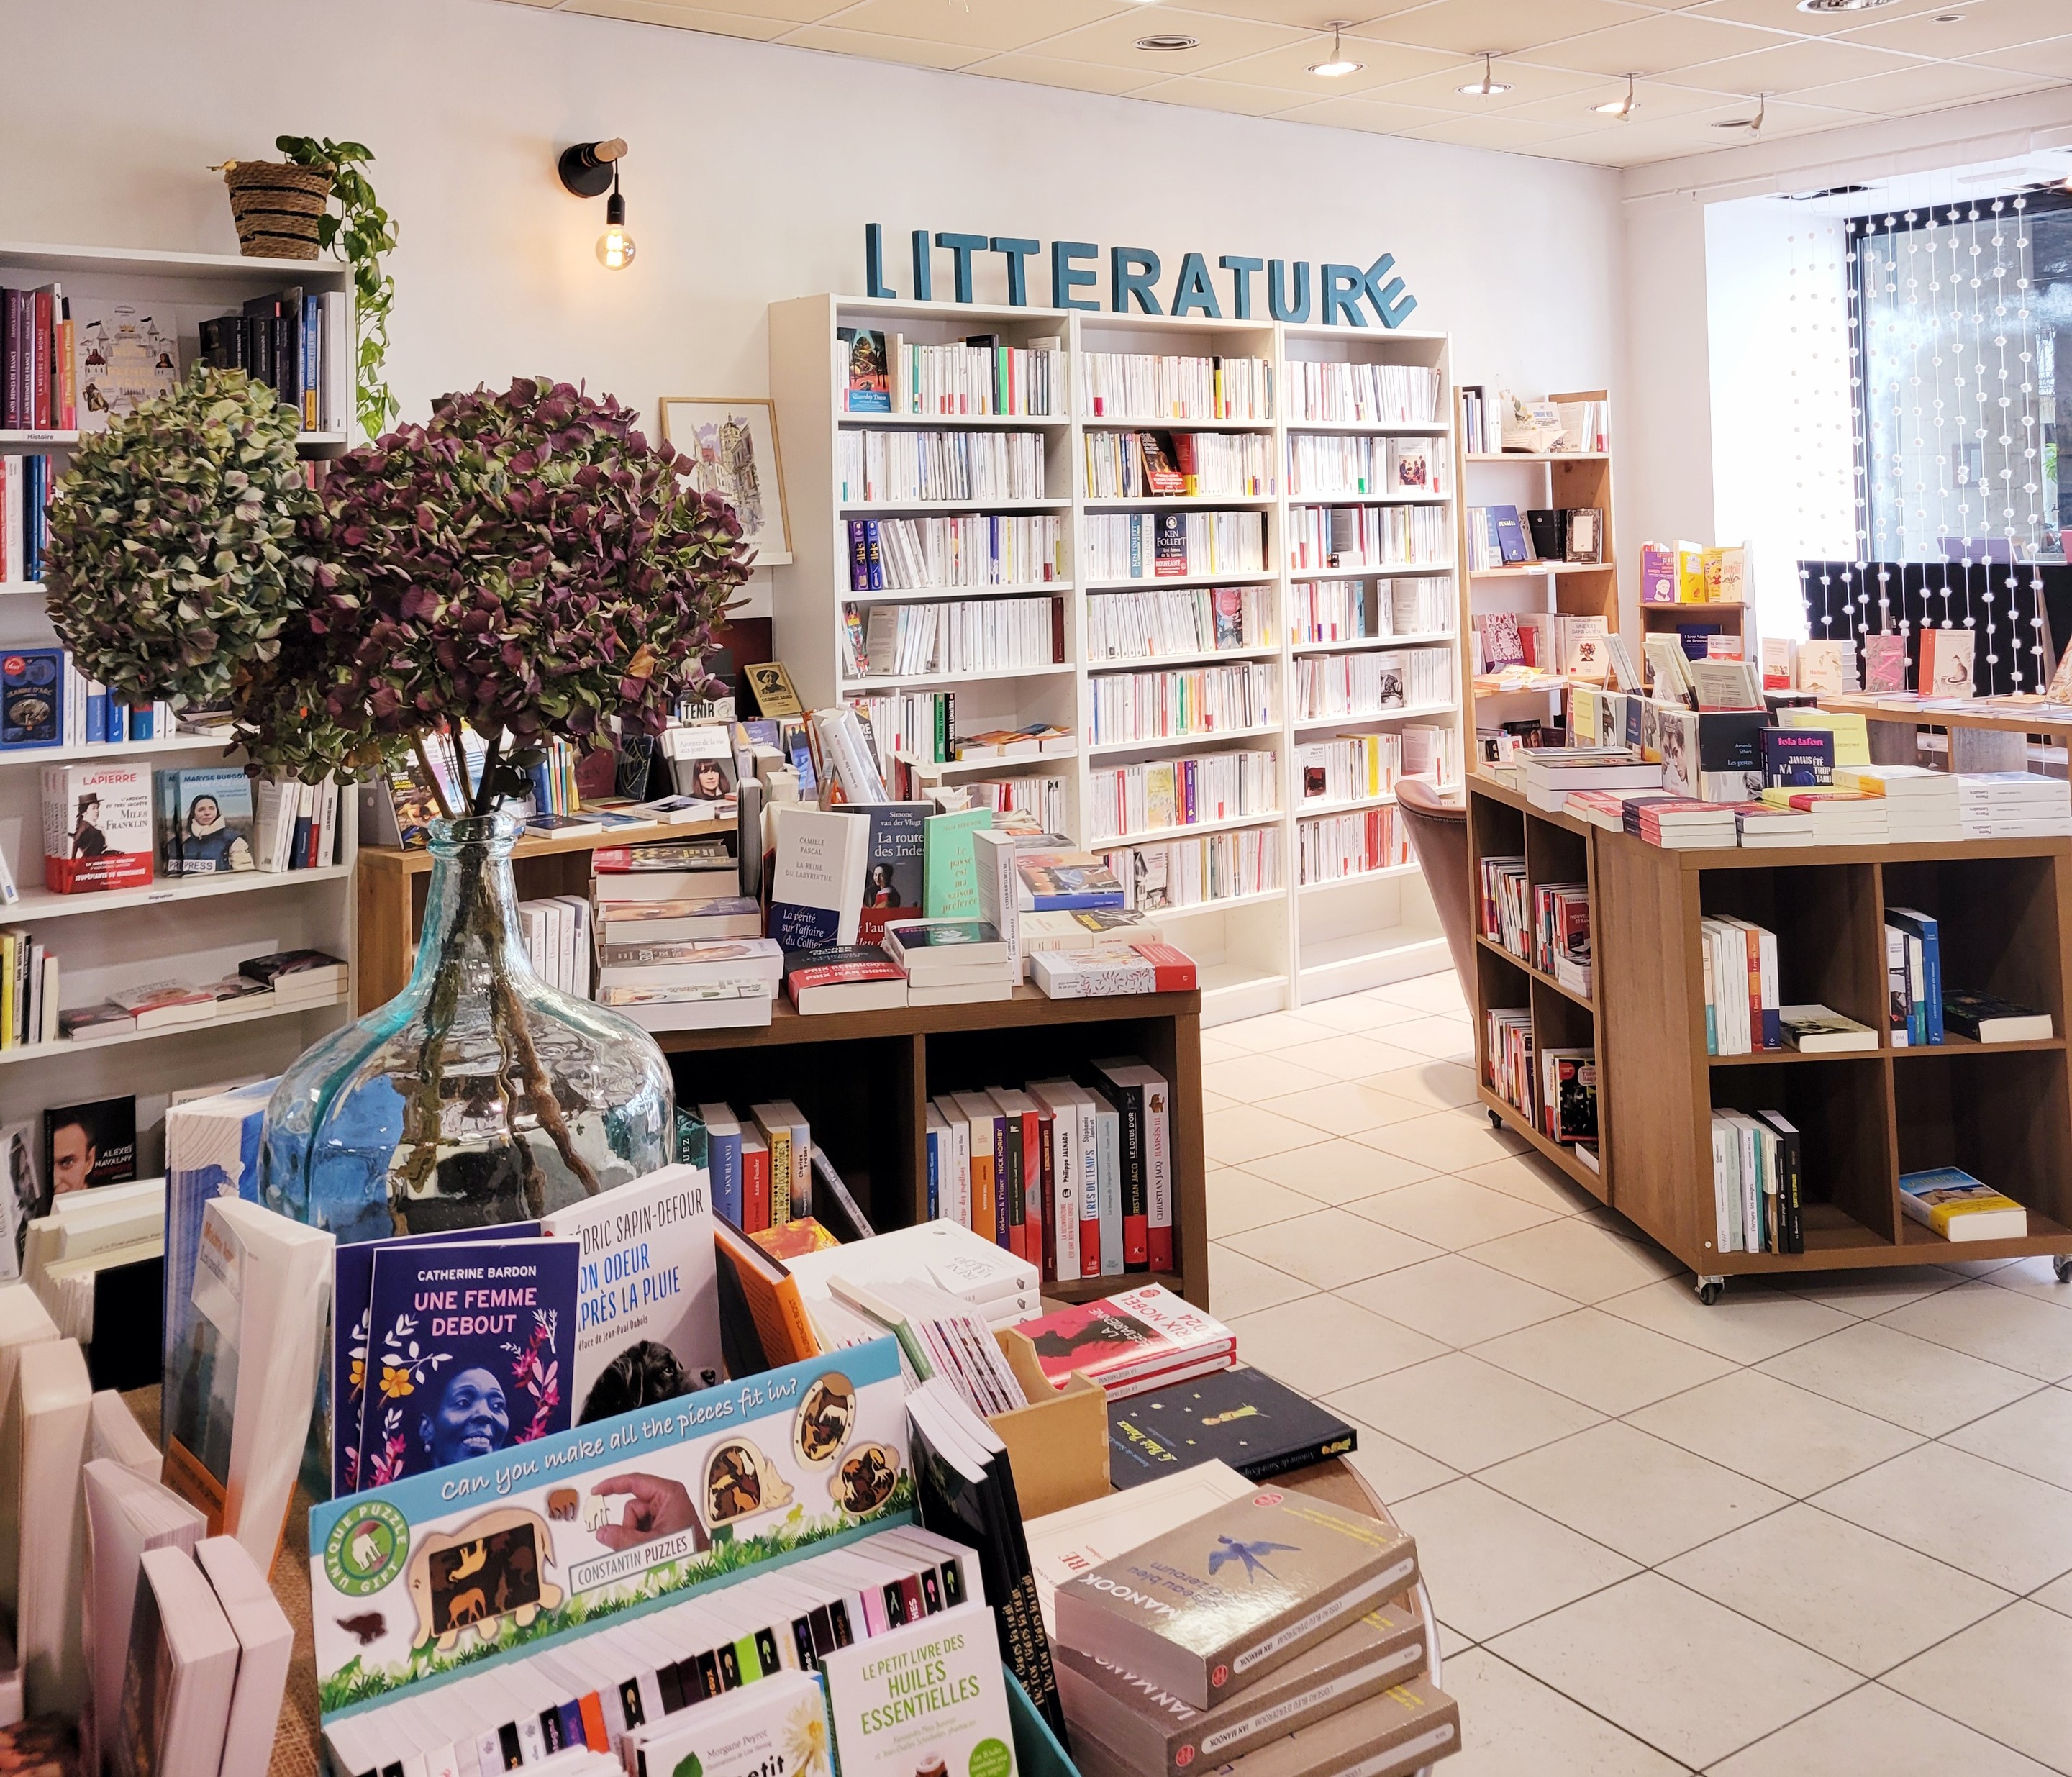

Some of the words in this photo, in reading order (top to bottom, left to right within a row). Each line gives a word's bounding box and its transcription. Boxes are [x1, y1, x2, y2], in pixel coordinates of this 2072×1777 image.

[865, 223, 1417, 329] LITTERATURE
[38, 352, 44, 360] DU
[1157, 537, 1186, 547] FOLLETT
[683, 702, 715, 719] TENIR
[1778, 736, 1797, 747] lola
[1798, 736, 1824, 747] lafon
[1789, 755, 1812, 765] JAMAIS
[1812, 755, 1825, 766] ÉTÉ
[1778, 764, 1793, 775] N'A
[1814, 765, 1831, 775] TROP
[83, 773, 137, 786] LAPIERRE
[1816, 774, 1832, 783] TARD
[106, 820, 147, 830] FRANKLIN
[799, 837, 825, 846] CAMILLE
[877, 832, 892, 843] La
[895, 833, 924, 843] route
[874, 845, 894, 857] des
[956, 847, 966, 856] Le
[184, 860, 213, 871] PRESS
[805, 863, 823, 871] REINE
[796, 871, 832, 881] LABYRINTHE
[955, 879, 967, 888] ma
[948, 889, 973, 899] saison
[783, 909, 792, 919] La
[794, 909, 816, 924] vérité
[782, 924, 794, 932] sur
[796, 923, 824, 938] l'affaire
[786, 935, 795, 946] du
[796, 937, 822, 949] Collier
[804, 965, 829, 974] PRIX
[102, 1145, 132, 1158] ALEXEI
[1130, 1150, 1136, 1159] LE
[94, 1153, 133, 1168] NAVALNY
[1085, 1150, 1095, 1176] TEMPS
[1063, 1158, 1071, 1183] Philippe
[1086, 1178, 1096, 1191] DU
[1084, 1193, 1096, 1218] ÎTRES
[570, 1221, 612, 1255] DRIC
[615, 1188, 704, 1244] SAPIN-DEFOUR
[417, 1268, 484, 1283] CATHERINE
[487, 1265, 537, 1279] BARDON
[580, 1265, 599, 1294] ON
[605, 1243, 649, 1285] ODEUR
[414, 1291, 458, 1312] UNE
[464, 1287, 537, 1309] FEMME
[578, 1297, 617, 1332] PRÈS
[622, 1283, 639, 1310] LA
[644, 1265, 681, 1304] PLUIE
[1120, 1294, 1168, 1322] NOBEL
[432, 1314, 517, 1337] DEBOUT
[1101, 1327, 1119, 1339] LA
[578, 1335, 594, 1351] éface
[596, 1332, 602, 1346] de
[603, 1322, 633, 1345] Jean-Paul
[633, 1316, 648, 1336] Dubois
[441, 1475, 490, 1501] can
[495, 1459, 540, 1494] you
[544, 1438, 605, 1469] make
[609, 1422, 638, 1450] all
[642, 1414, 673, 1440] the
[677, 1400, 734, 1437] pieces
[737, 1386, 763, 1413] fit
[768, 1377, 798, 1408] in?
[327, 1516, 353, 1589] UNIQUE
[358, 1504, 407, 1545] PUZZLE
[578, 1552, 642, 1586] CONSTANTIN
[645, 1535, 688, 1565] PUZZLES
[360, 1562, 398, 1592] GIFT
[1077, 1573, 1183, 1621] MANOOK
[1264, 1642, 1273, 1653] IAN
[863, 1664, 876, 1681] LE
[878, 1653, 908, 1676] PETIT
[911, 1641, 941, 1664] LIVRE
[943, 1634, 965, 1653] DES
[1240, 1645, 1264, 1668] MANOOK
[887, 1660, 947, 1699] HUILES
[860, 1675, 980, 1736] ESSENTIELLES
[1238, 1724, 1250, 1735] IAN
[1208, 1730, 1238, 1747] MANOOK
[706, 1740, 742, 1760] Morgane
